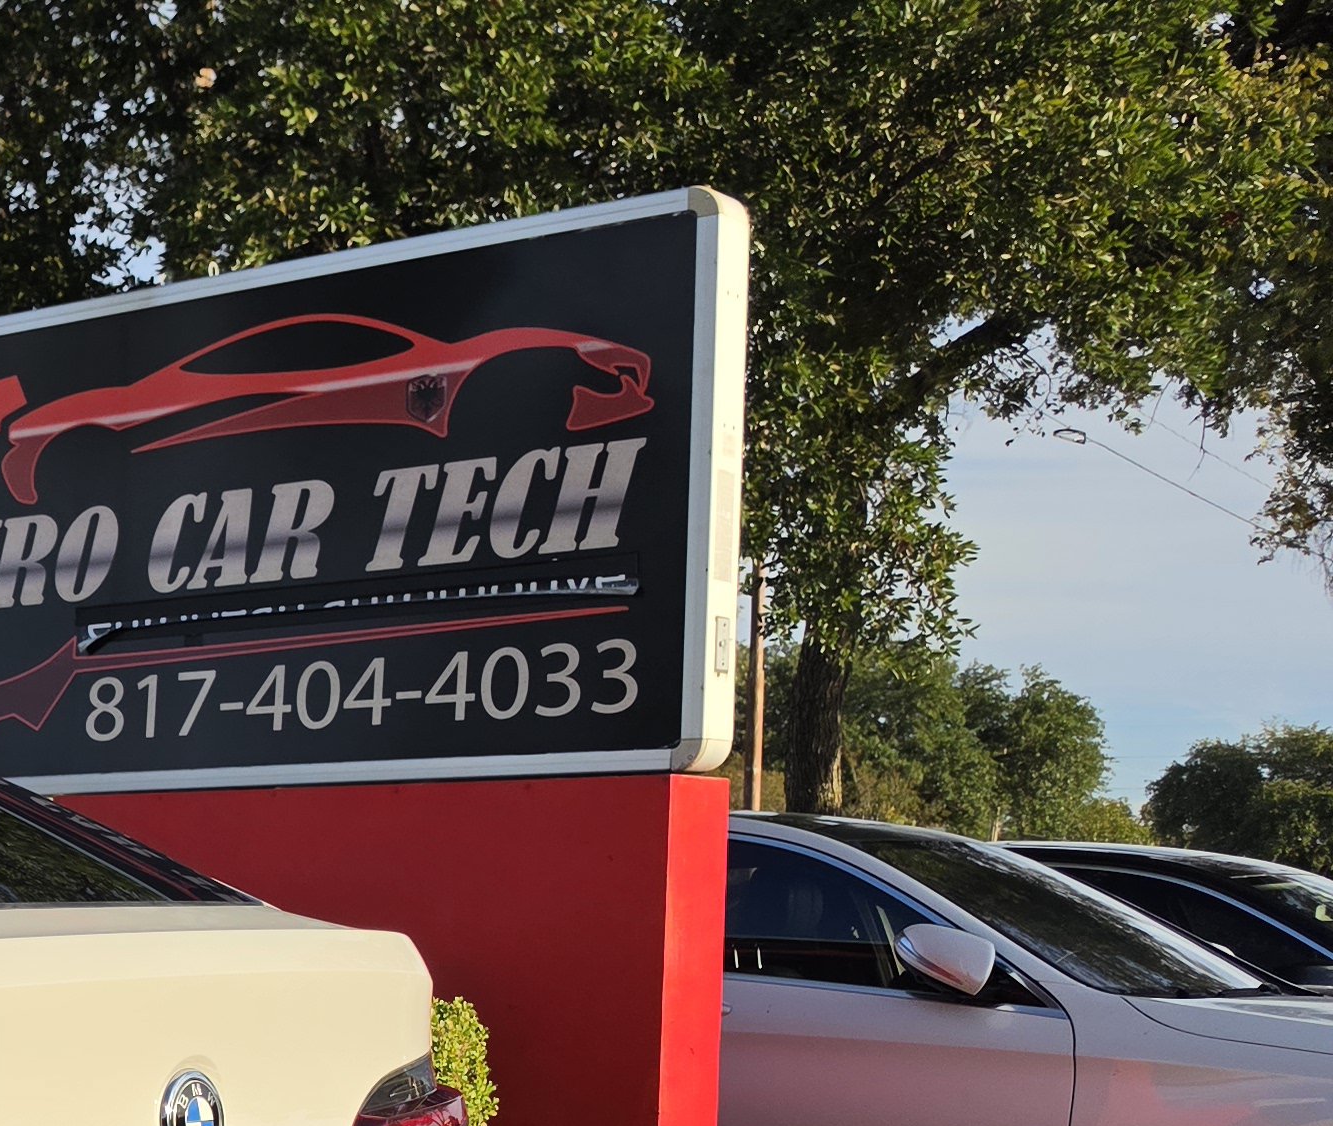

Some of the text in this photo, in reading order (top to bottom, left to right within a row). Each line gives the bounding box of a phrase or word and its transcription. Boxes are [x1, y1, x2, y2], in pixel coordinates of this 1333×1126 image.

[147, 478, 335, 594] CAR
[364, 436, 647, 574] TECH
[84, 637, 640, 743] 817-404-4033
[176, 1082, 217, 1110] BMW
